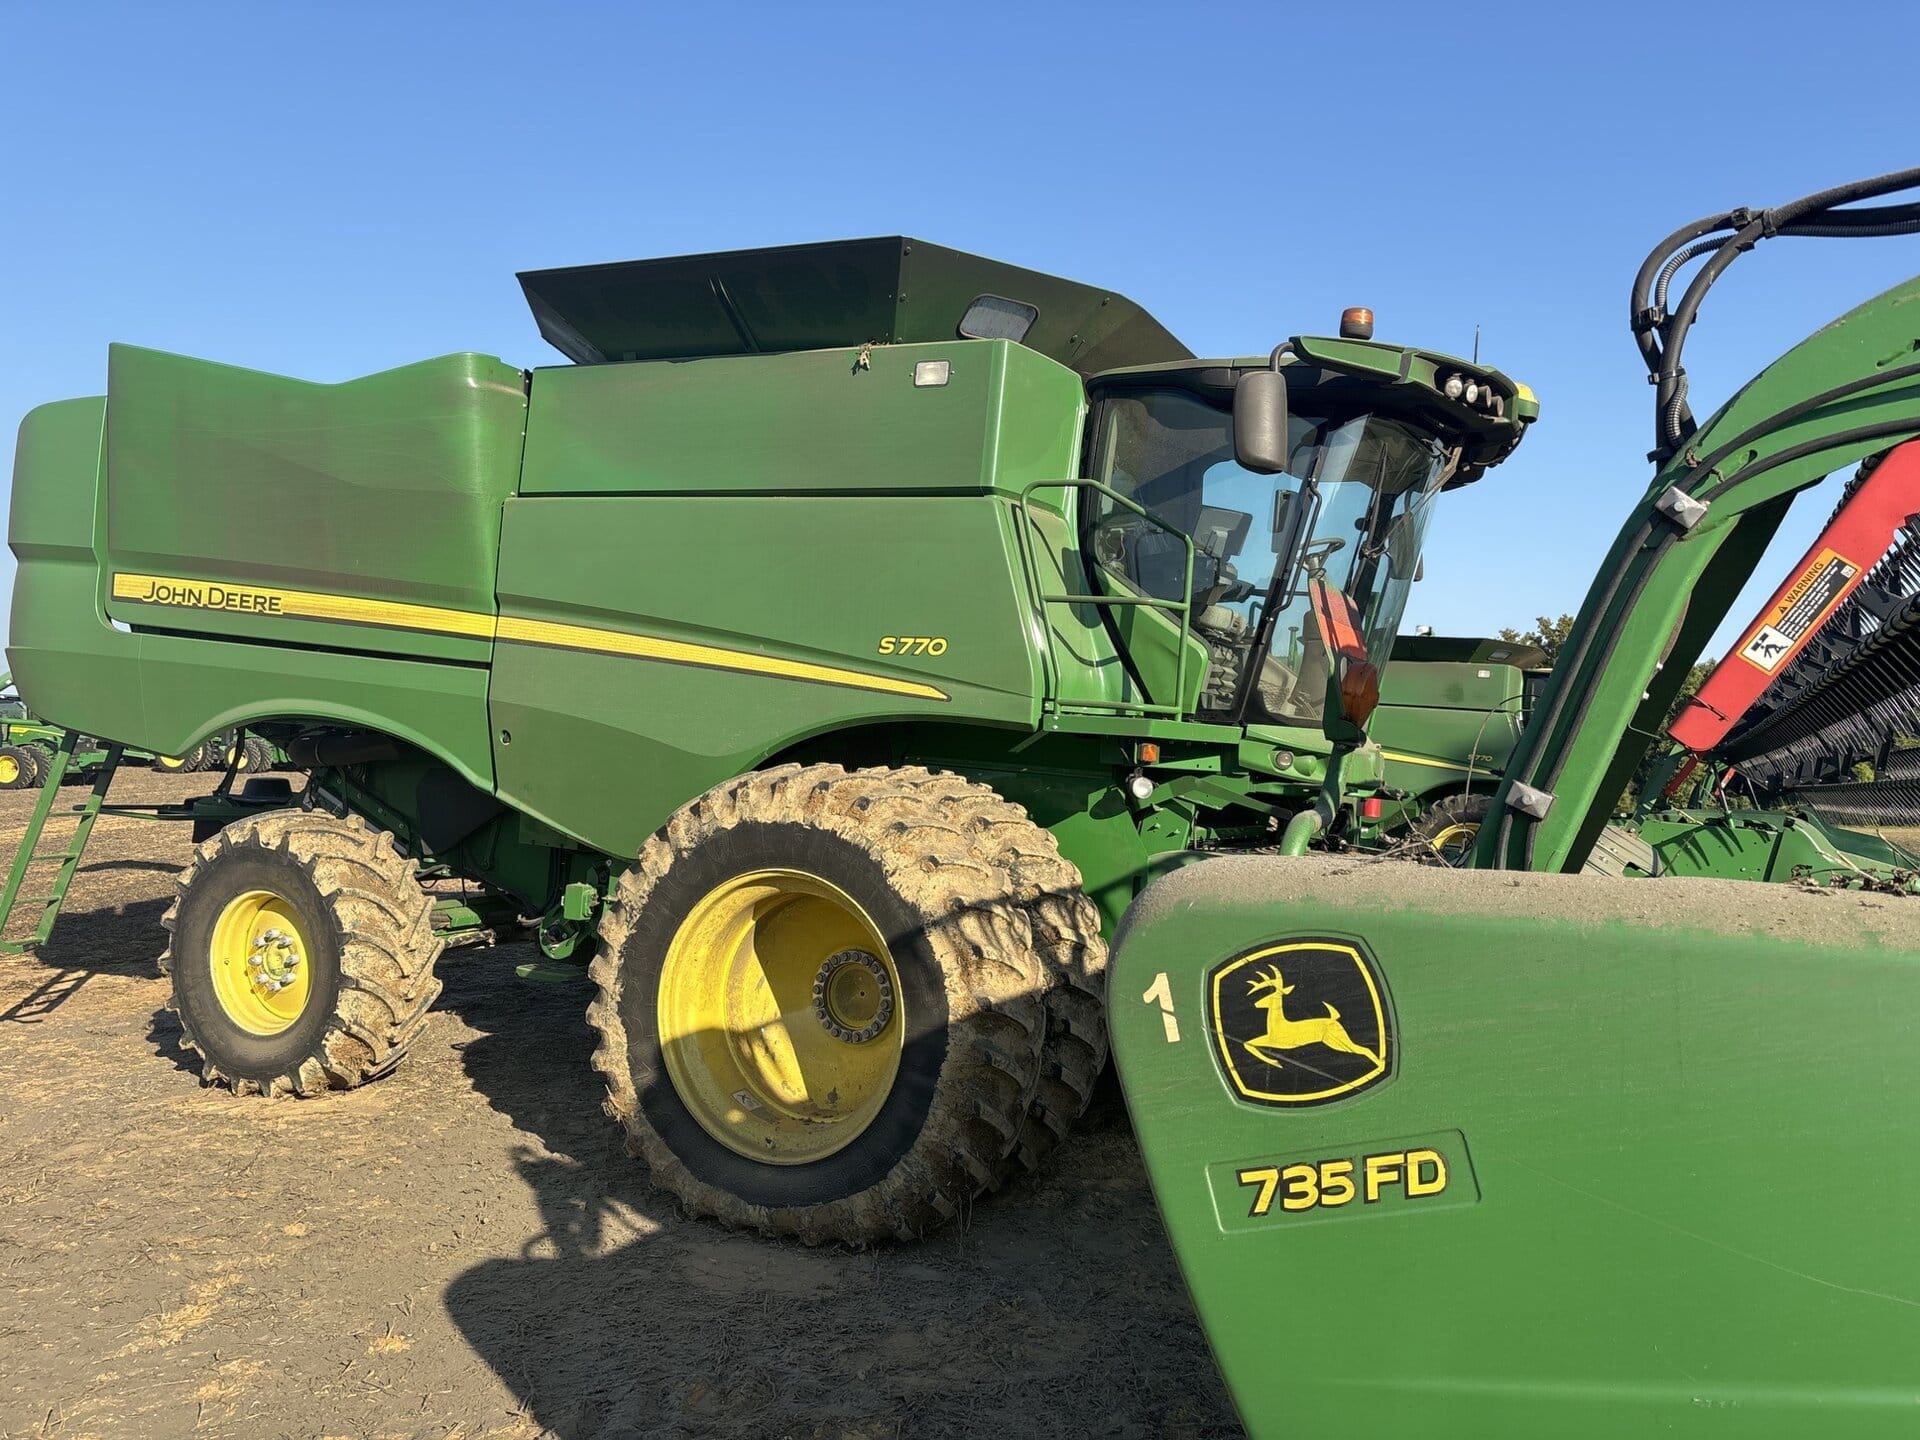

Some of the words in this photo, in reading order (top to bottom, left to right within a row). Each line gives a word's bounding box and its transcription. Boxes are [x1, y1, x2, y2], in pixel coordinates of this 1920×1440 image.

[143, 581, 202, 606] JOHN
[208, 587, 282, 613] DEERE
[1785, 561, 1824, 604] WARNING
[878, 636, 948, 657] S770
[1143, 972, 1180, 1043] 1
[1236, 1160, 1355, 1218] 735
[1364, 1147, 1448, 1204] FD
